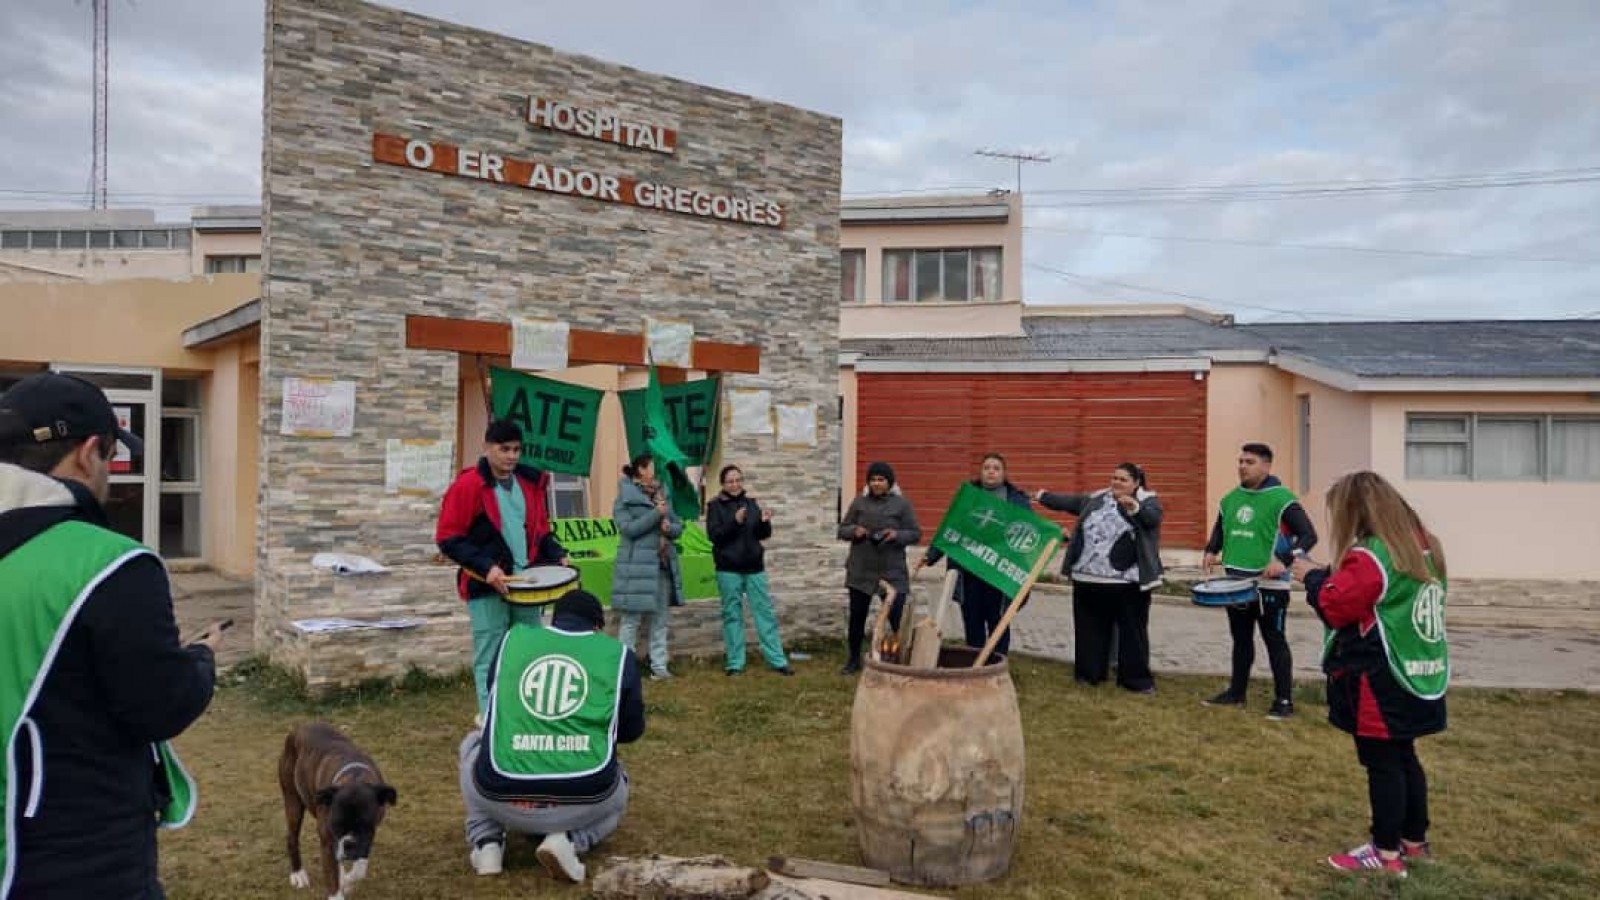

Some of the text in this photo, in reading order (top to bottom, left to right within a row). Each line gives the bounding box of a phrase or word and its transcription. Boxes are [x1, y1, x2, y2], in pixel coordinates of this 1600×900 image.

[528, 98, 674, 153] HOSPITAL
[635, 184, 782, 226] GREGORES
[505, 386, 586, 442] ATE
[551, 517, 619, 541] RABAJ
[524, 659, 582, 716] ATE
[512, 735, 591, 751] SANTA CRUZ
